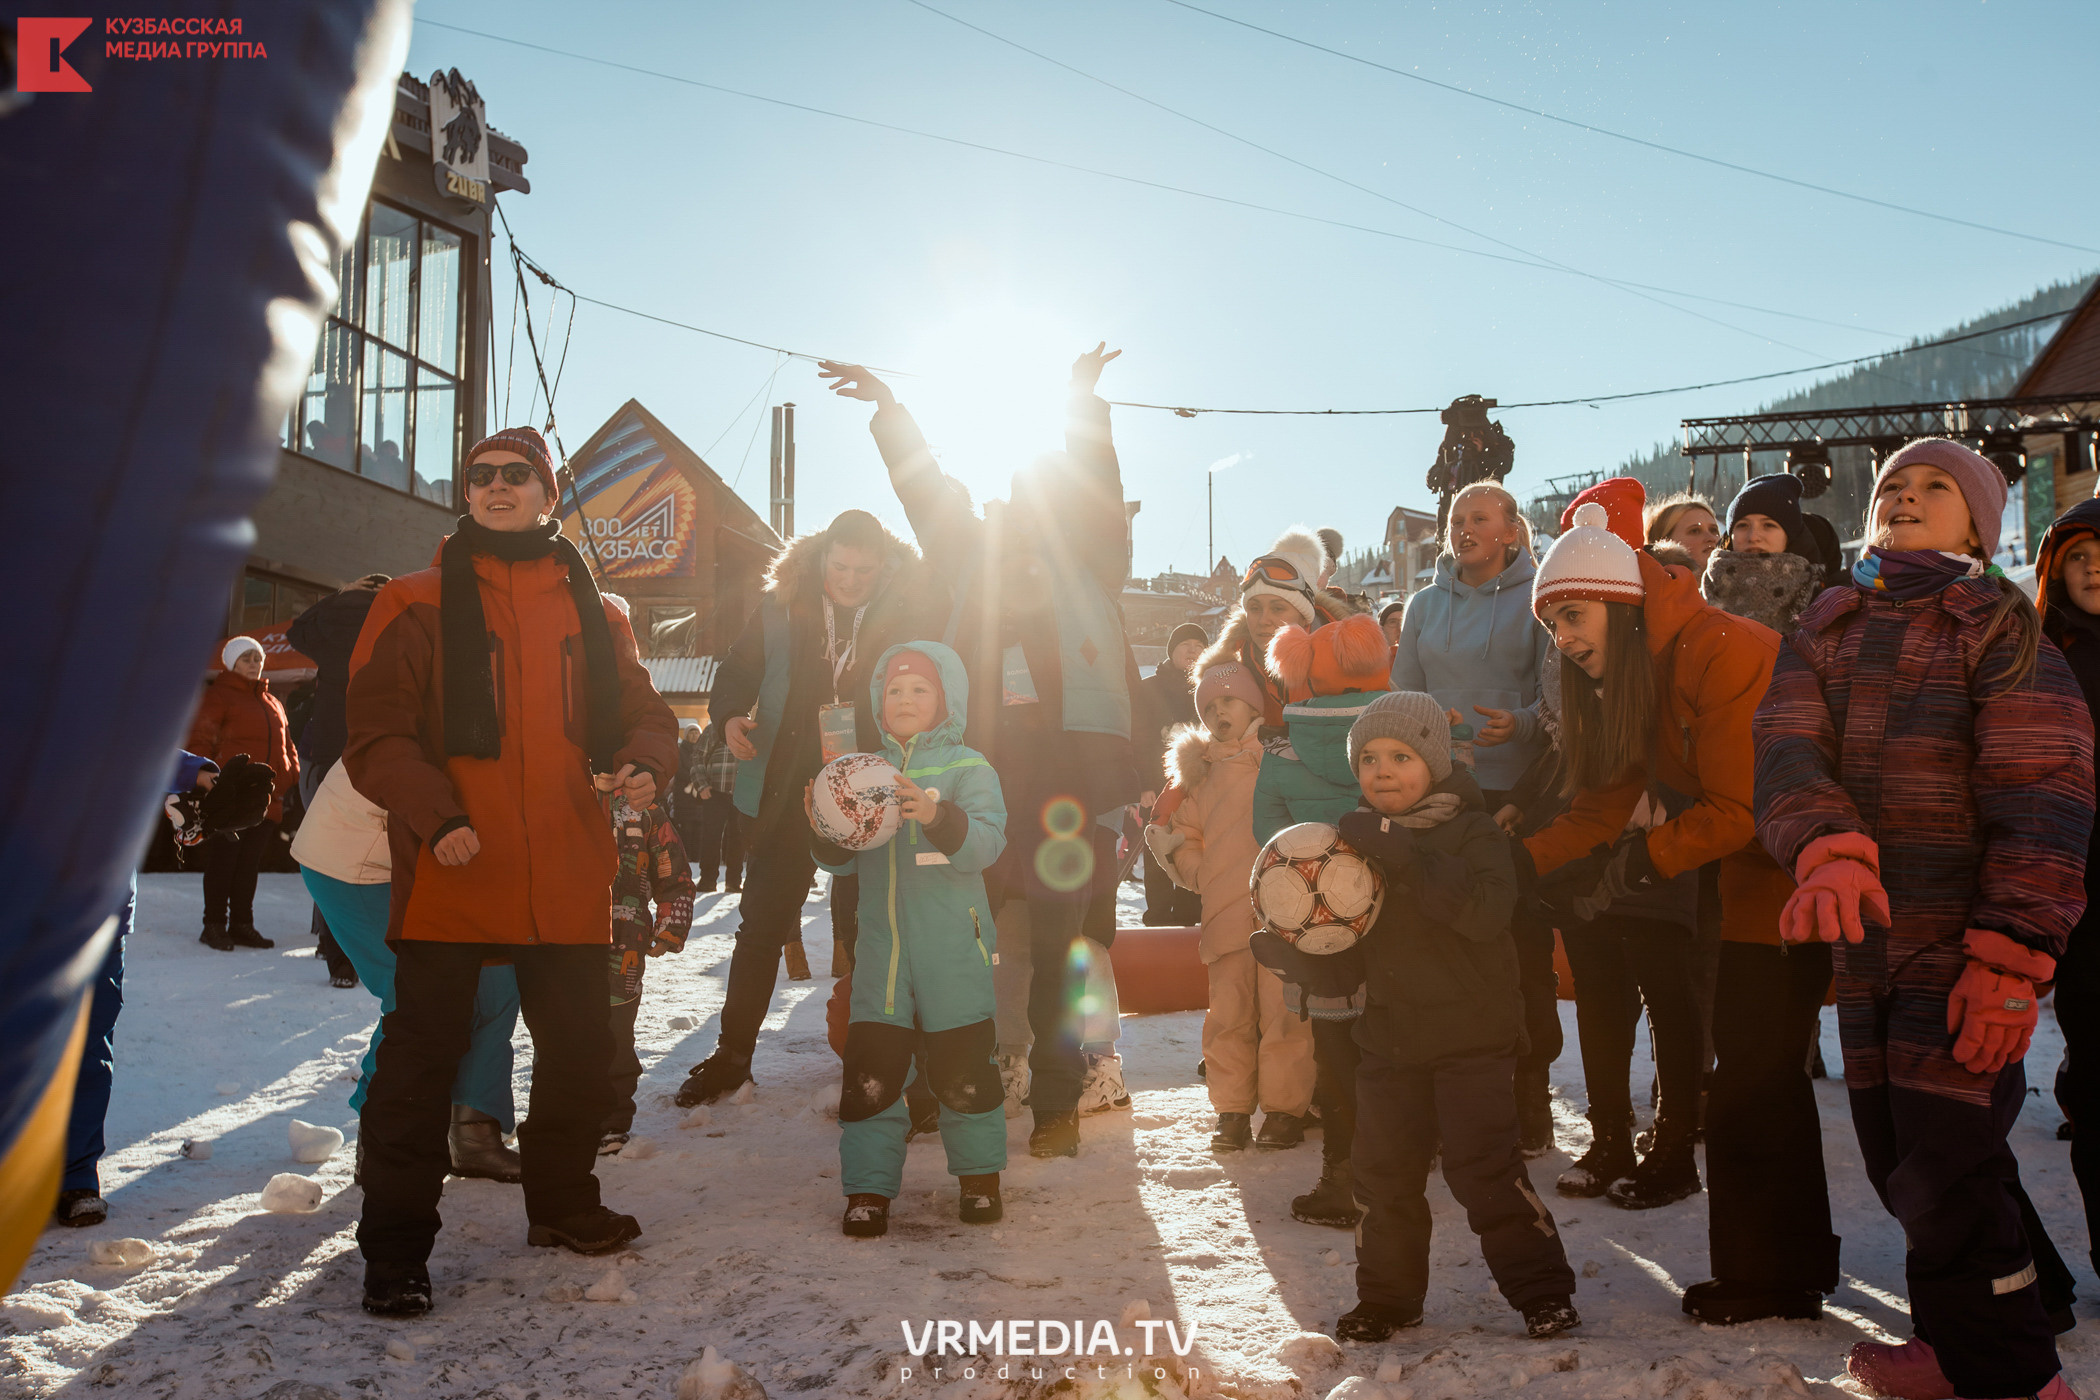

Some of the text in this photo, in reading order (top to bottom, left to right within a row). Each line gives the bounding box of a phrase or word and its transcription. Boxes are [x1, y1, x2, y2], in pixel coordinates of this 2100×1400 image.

[447, 171, 486, 204] ZUBR
[579, 517, 622, 538] 300
[579, 540, 678, 559] КУЗБАСС
